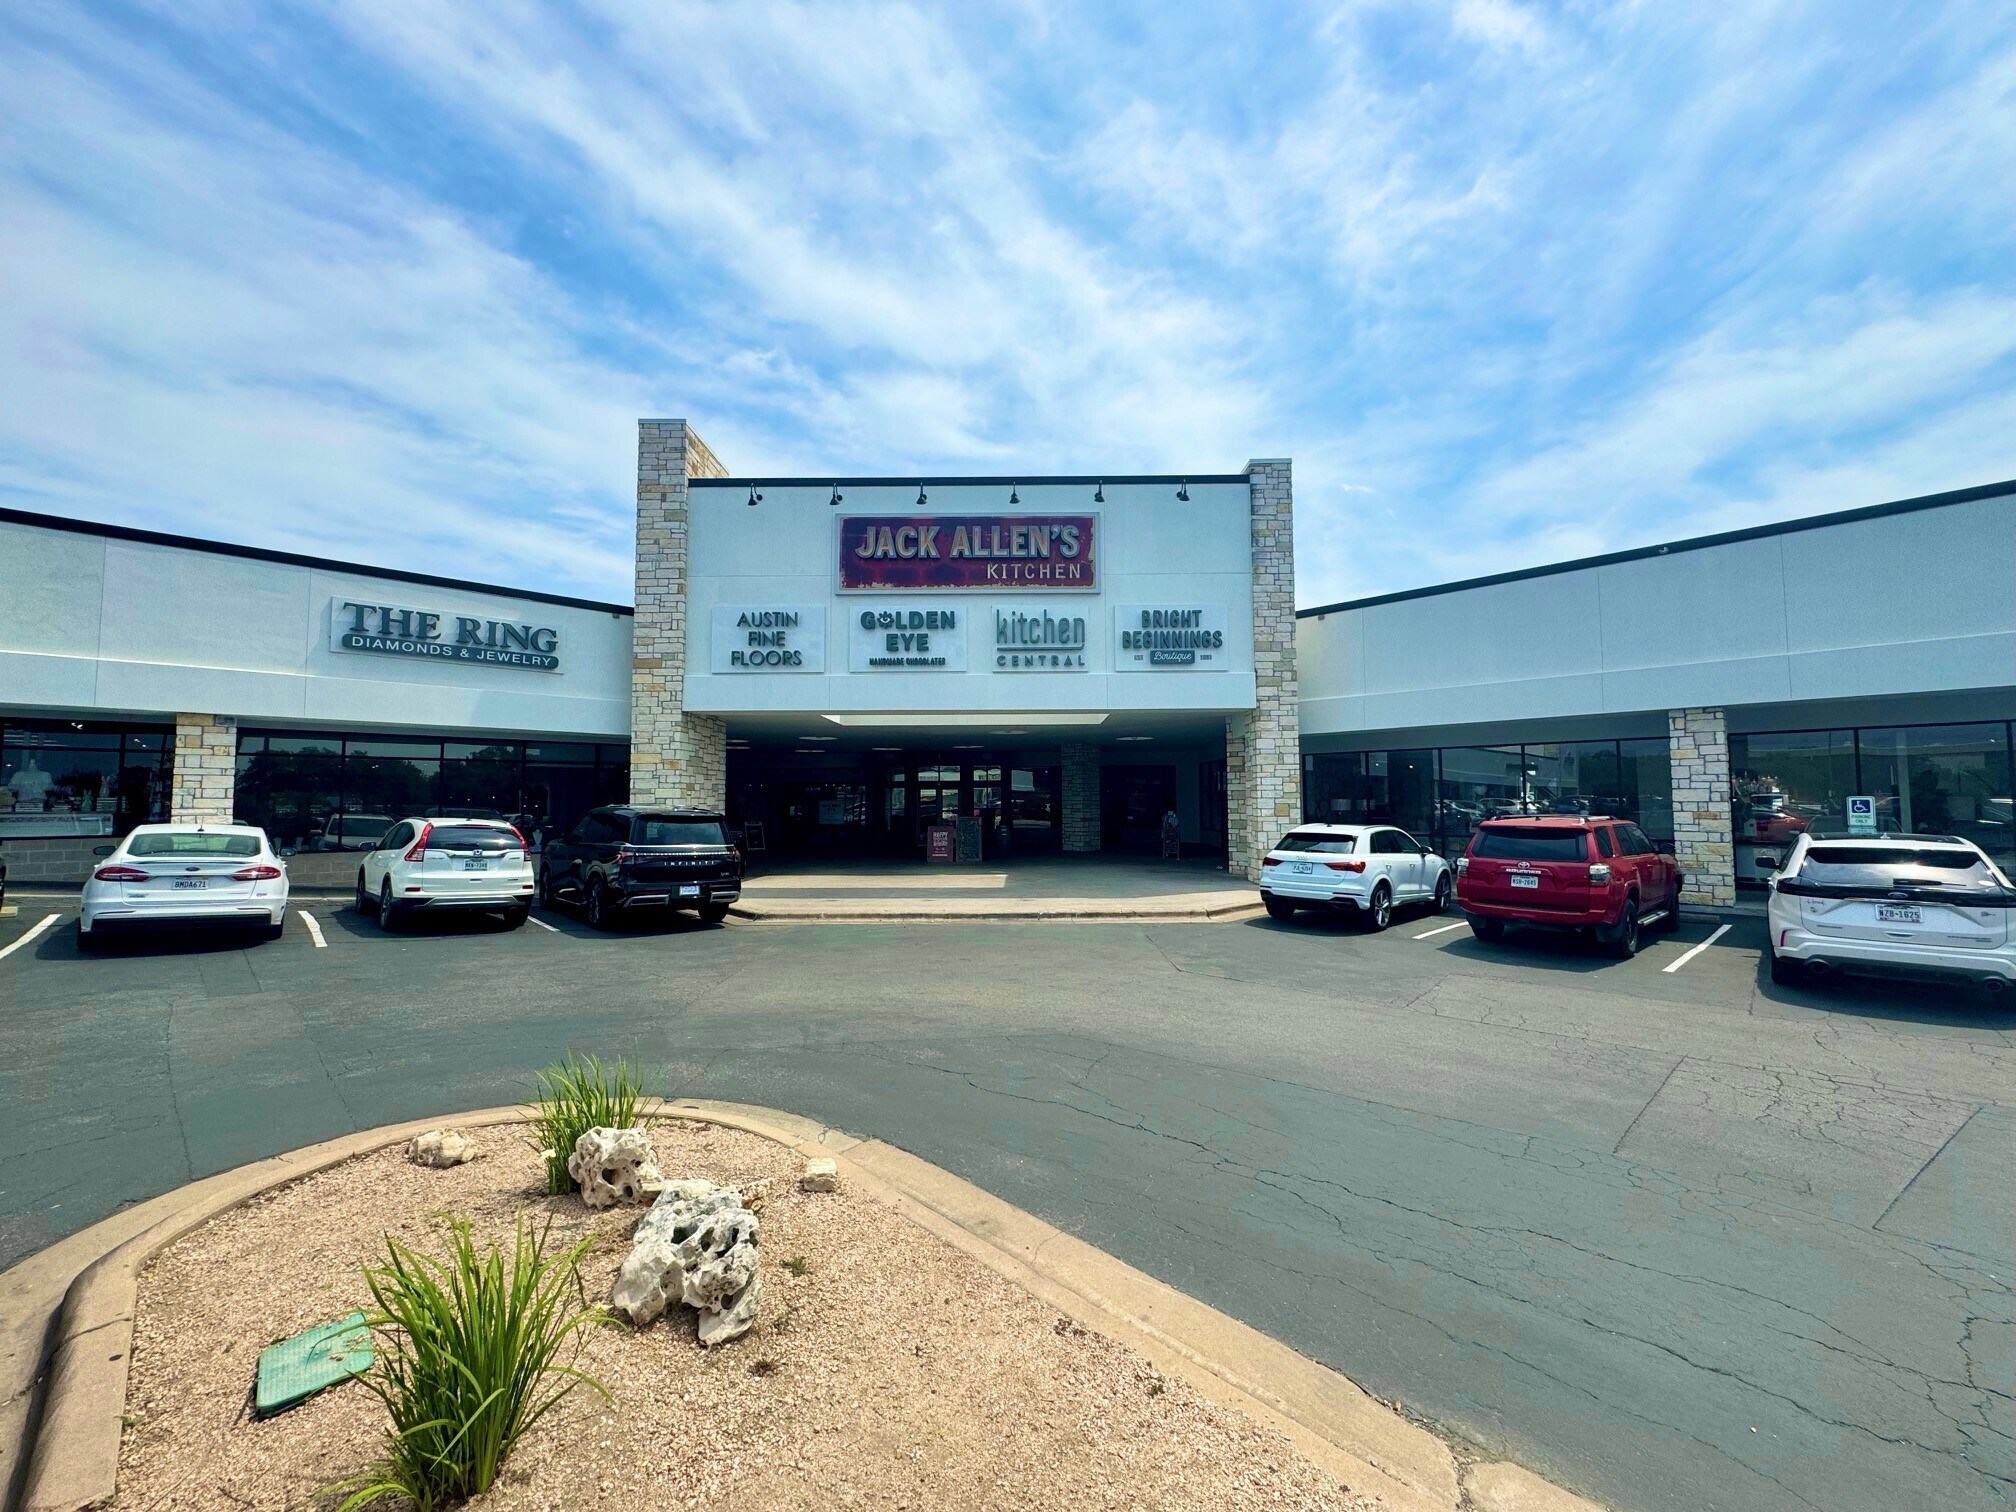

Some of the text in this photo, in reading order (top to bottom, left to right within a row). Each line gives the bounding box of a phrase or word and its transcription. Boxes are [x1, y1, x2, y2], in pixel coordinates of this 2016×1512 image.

[855, 524, 1080, 559] JACK ALLEN'S
[986, 563, 1081, 579] KITCHEN
[343, 602, 559, 653] THE RING
[736, 611, 798, 628] AUSTIN
[996, 609, 1086, 644] kitchen
[1141, 609, 1202, 629] BRIGHT
[748, 631, 786, 647] FINE
[886, 633, 930, 652] EYE
[1122, 630, 1223, 650] BEGINNINGS
[352, 636, 551, 666] DIAMONDS & JEWELRY
[731, 650, 803, 667] FLOORS
[1153, 651, 1193, 663] Boutique
[996, 655, 1086, 667] CENTRAL
[1879, 909, 1920, 919] NZB-1625
